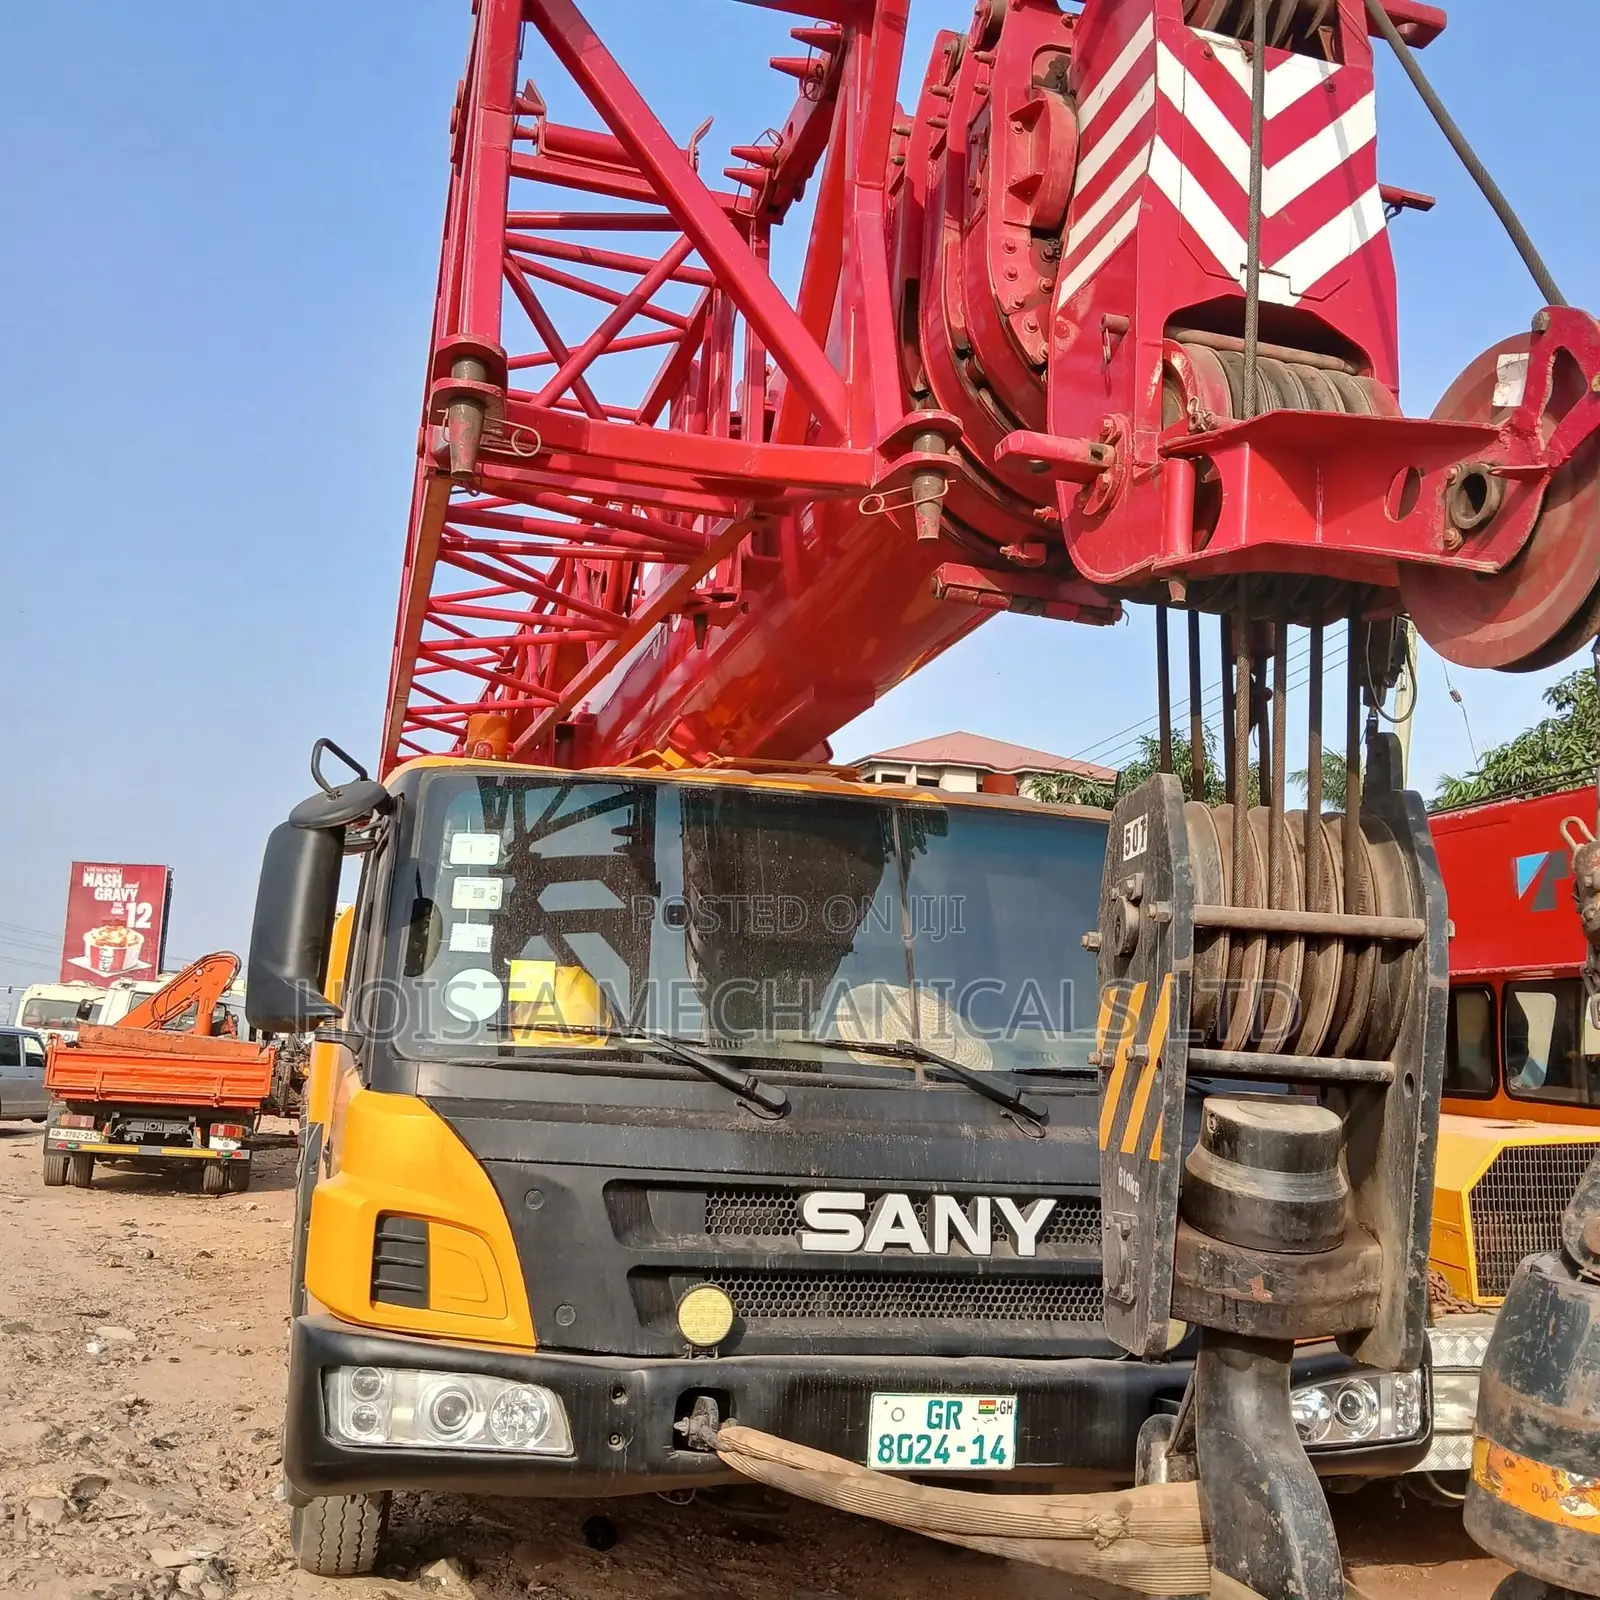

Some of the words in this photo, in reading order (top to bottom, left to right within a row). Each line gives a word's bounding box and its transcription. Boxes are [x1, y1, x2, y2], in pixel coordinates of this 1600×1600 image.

[83, 872, 122, 888] MASH
[94, 887, 138, 902] GRAVY
[126, 902, 153, 929] 12
[1118, 1166, 1140, 1203] 610kg
[799, 1191, 1057, 1257] SANY
[926, 1400, 963, 1430] GR
[1000, 1402, 1014, 1415] GH
[877, 1433, 1007, 1464] 8024-14
